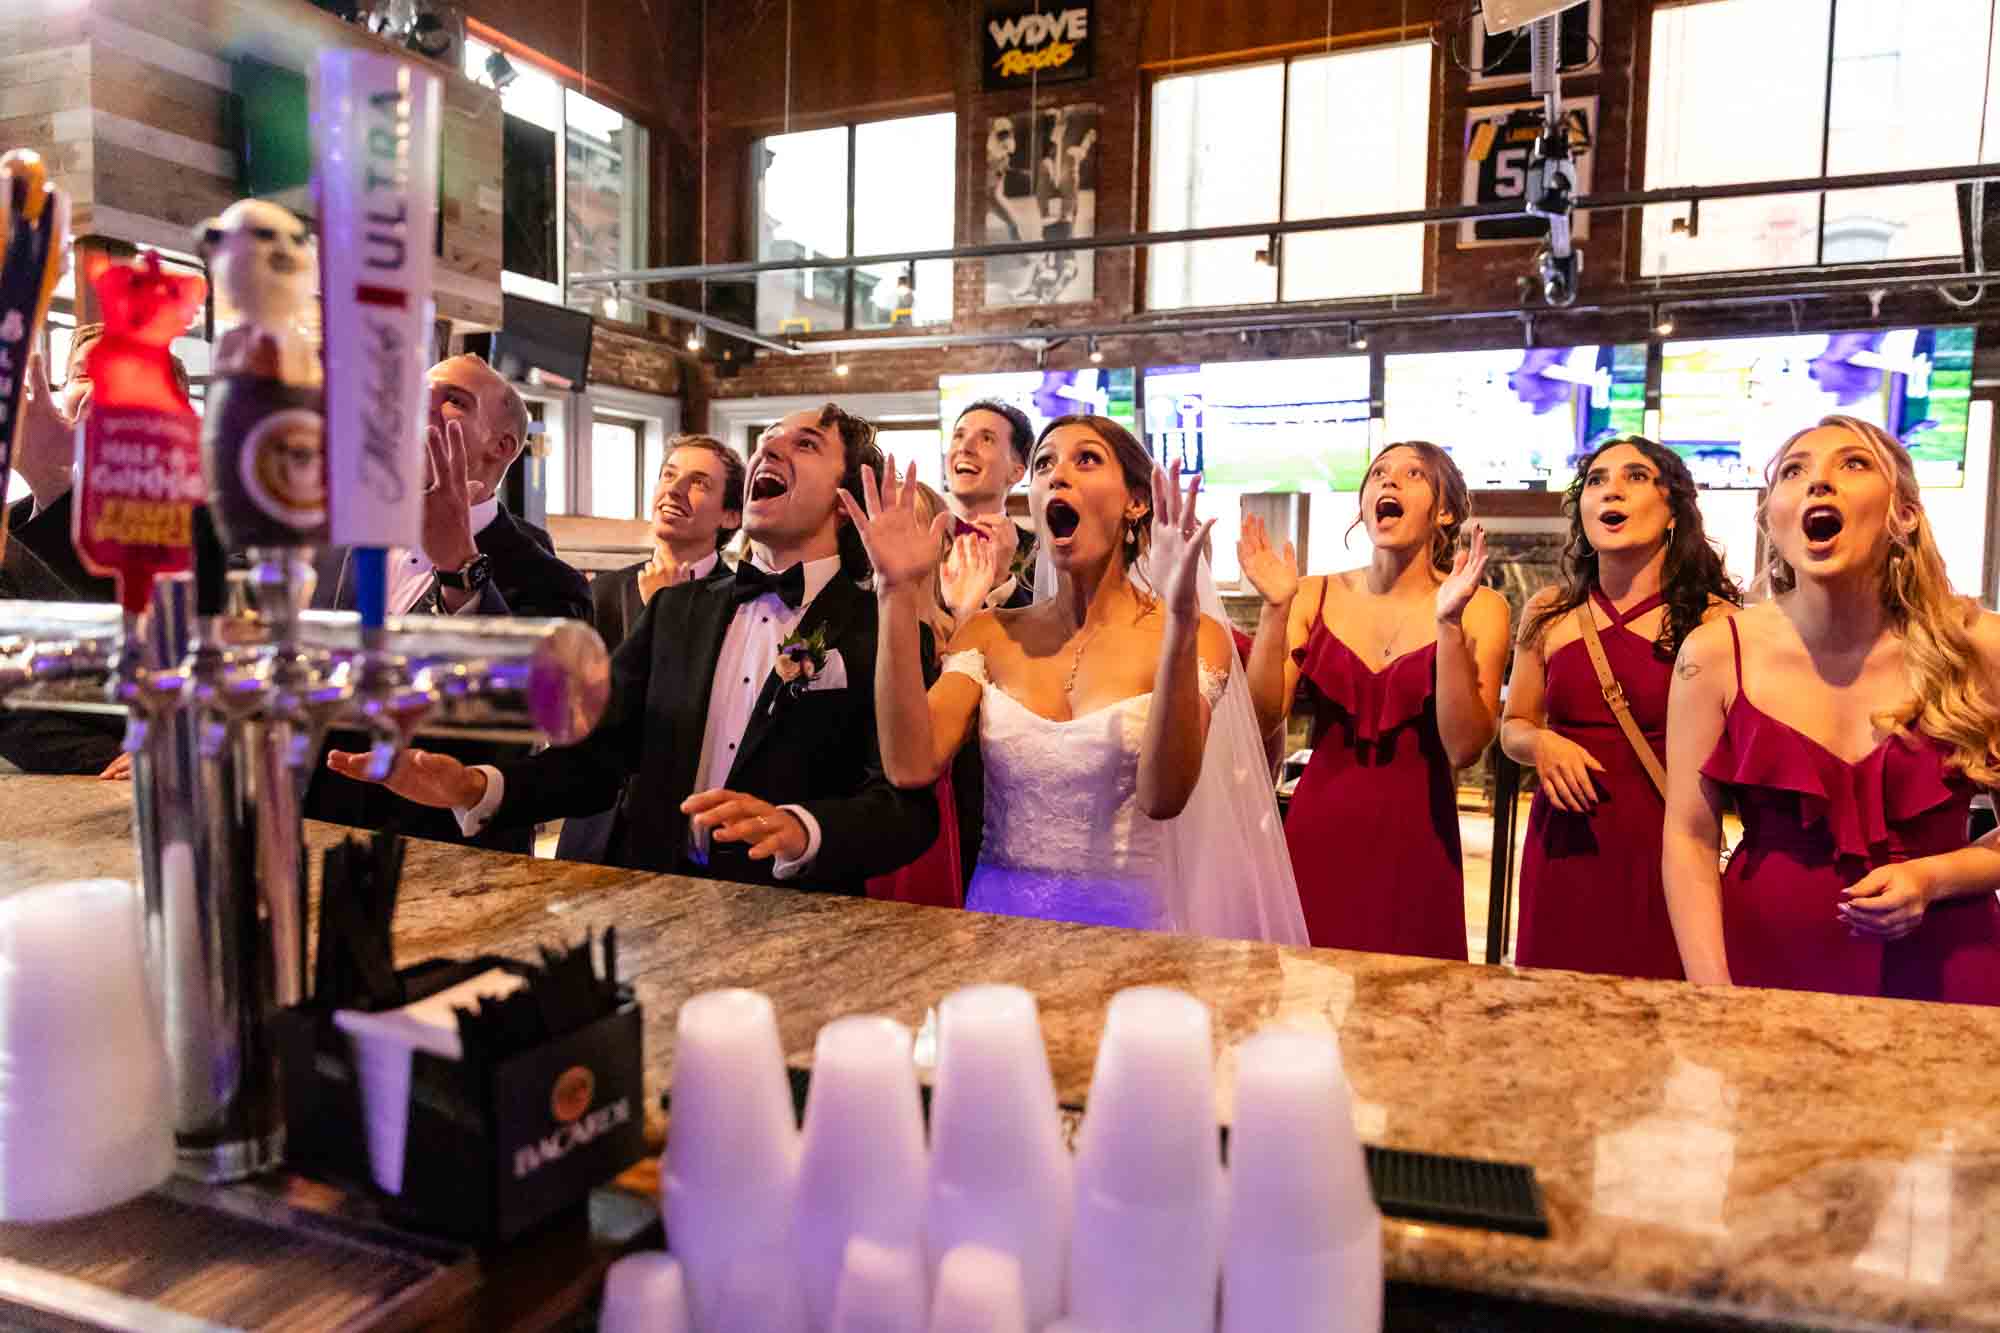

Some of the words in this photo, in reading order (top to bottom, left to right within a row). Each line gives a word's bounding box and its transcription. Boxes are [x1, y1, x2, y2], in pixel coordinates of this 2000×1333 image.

[988, 7, 1088, 49] WDVE
[994, 40, 1074, 77] Rocks
[365, 91, 408, 271] ULTRA
